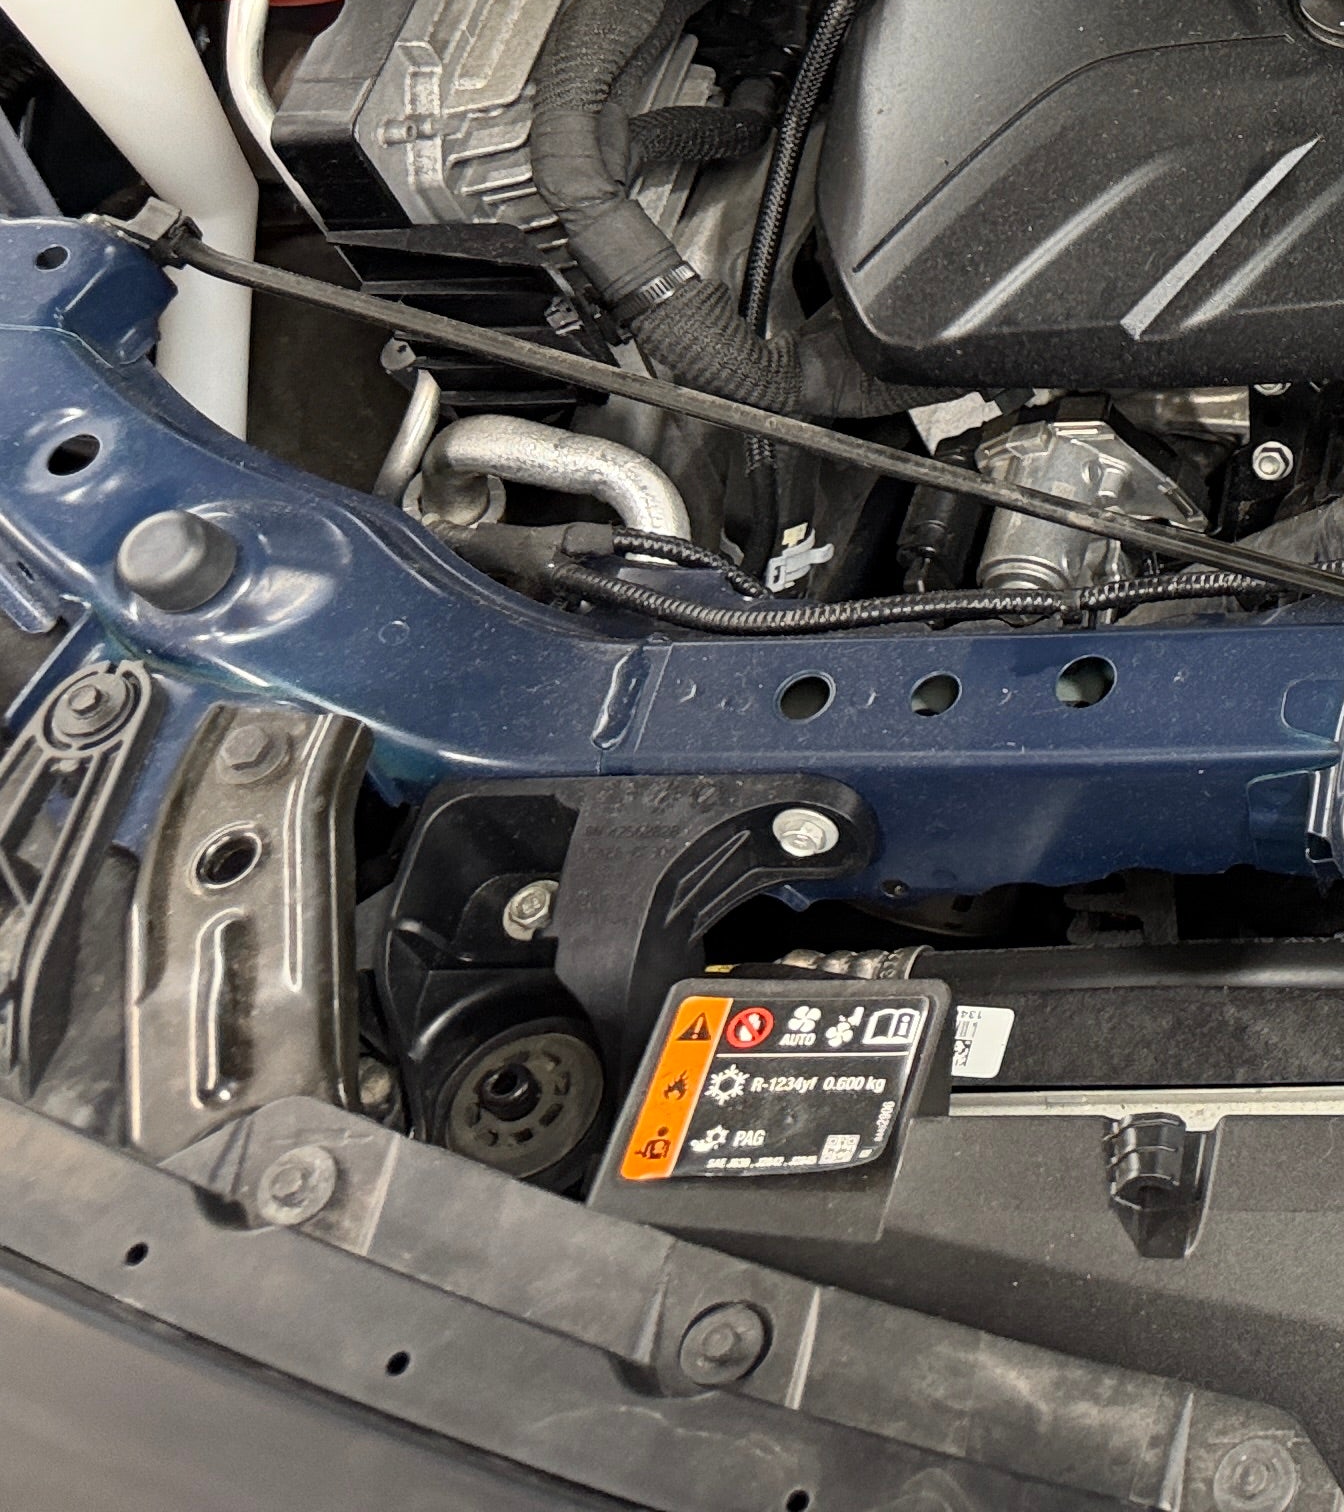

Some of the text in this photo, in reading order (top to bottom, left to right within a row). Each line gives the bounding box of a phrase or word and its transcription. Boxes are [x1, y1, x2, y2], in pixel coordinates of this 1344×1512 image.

[779, 1033, 817, 1047] AUTO
[751, 1076, 887, 1094] R-1234yf 0.600 kg
[733, 1129, 767, 1147] PAG
